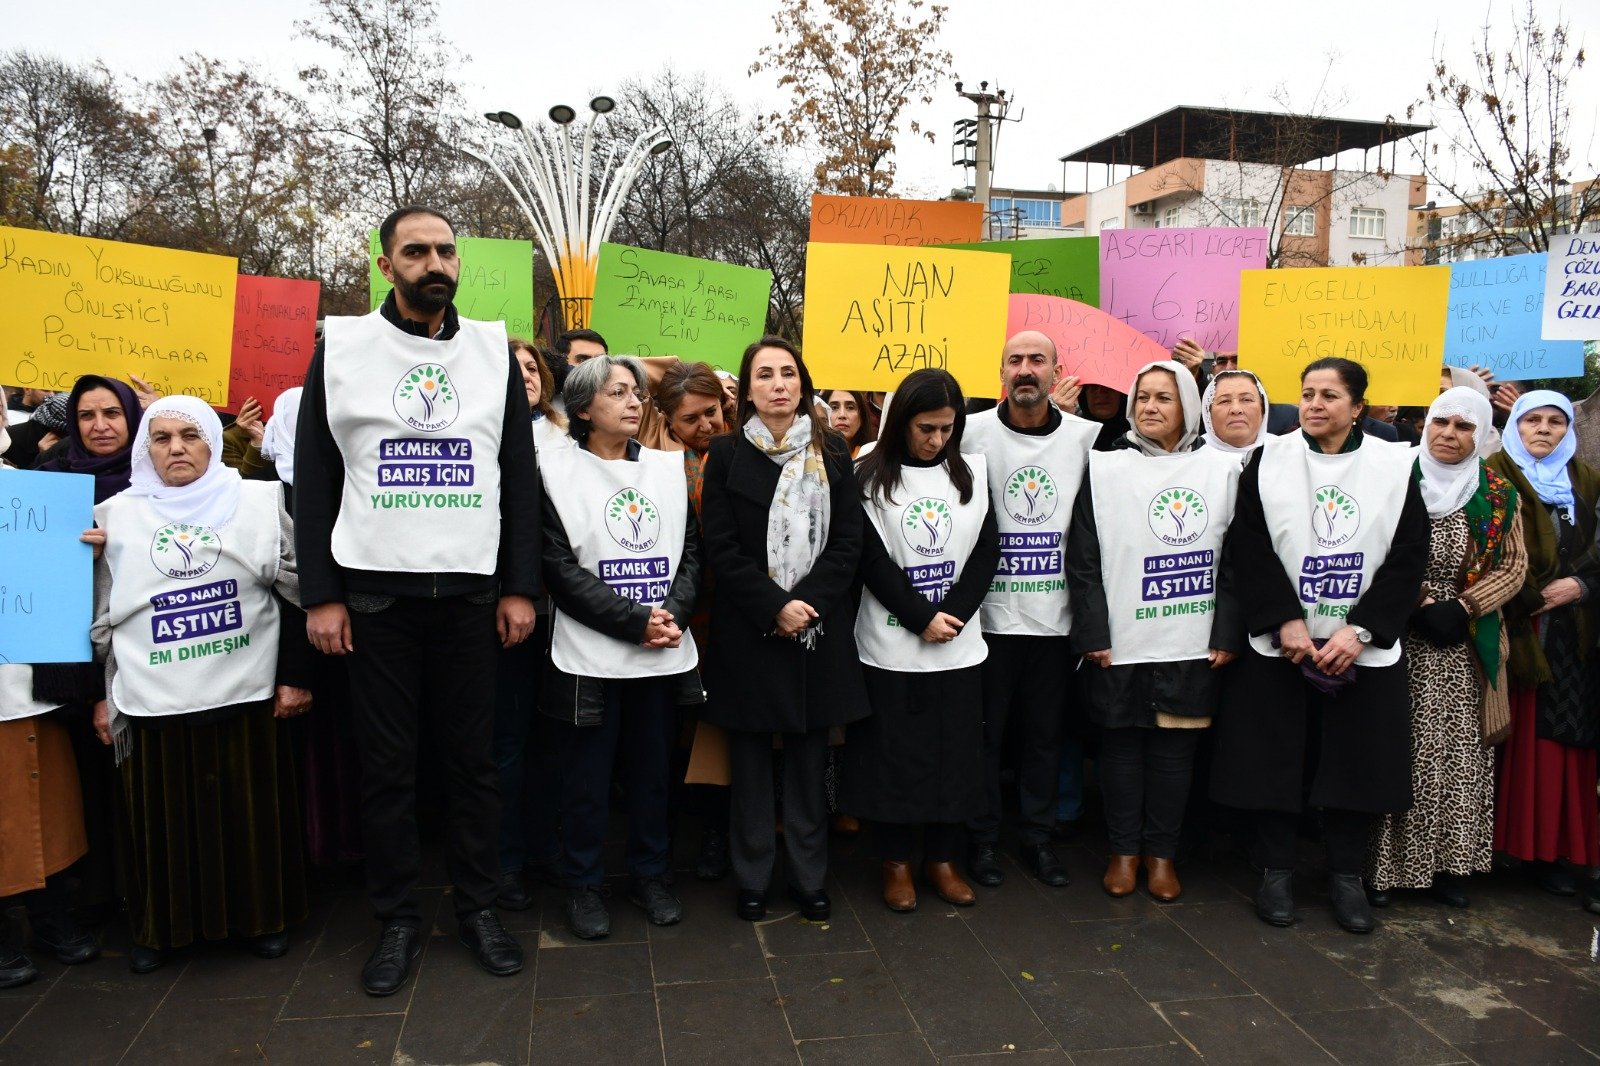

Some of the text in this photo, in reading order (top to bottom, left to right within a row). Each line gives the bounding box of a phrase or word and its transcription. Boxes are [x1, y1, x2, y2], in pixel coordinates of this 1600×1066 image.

[817, 202, 922, 232] OKUMAK
[0, 237, 71, 278] KADIN
[1105, 232, 1268, 261] ASGARİ ÜCRET
[882, 261, 955, 299] NAN
[64, 281, 169, 326] ÖNLEYİCİ
[617, 285, 751, 331] EKMEK VE BARIŞ
[1488, 298, 1512, 317] VE
[840, 298, 926, 338] AŞİTİ
[43, 315, 209, 363] POLİTİKALARA
[872, 336, 949, 373] AZADİ
[408, 416, 449, 430] DEM PARTİ
[385, 442, 469, 457] EKMEK VE
[382, 463, 470, 487] BARIŞ İÇİN
[370, 491, 483, 509] YÜRÜYORUZ
[1013, 512, 1047, 524] DEM PARTİ
[620, 536, 655, 550] DEM PARTİ
[998, 533, 1060, 546] JI BO NAN Û
[1162, 530, 1199, 545] DEM PARTİ
[916, 544, 931, 555] DEM
[1147, 551, 1212, 570] JI BO NAN Û
[1327, 557, 1352, 568] NAN
[1354, 553, 1362, 566] Û
[168, 561, 211, 578] DEM PARTİ
[603, 560, 666, 577] EKMEK VE
[913, 569, 928, 580] BO
[944, 561, 953, 575] Û
[996, 552, 1059, 575] AŞTIYÊ
[156, 580, 235, 608] JI BO NAN Û
[647, 581, 668, 603] İÇİN
[988, 579, 1066, 594] EM DIMEŞIN
[1146, 571, 1212, 598] AŞTIYÊ
[1302, 574, 1359, 602] AŞTIYÊ
[156, 603, 238, 639] AŞTIYÊ
[1135, 606, 1157, 620] EM
[149, 633, 250, 665] EM DIMEŞIN
